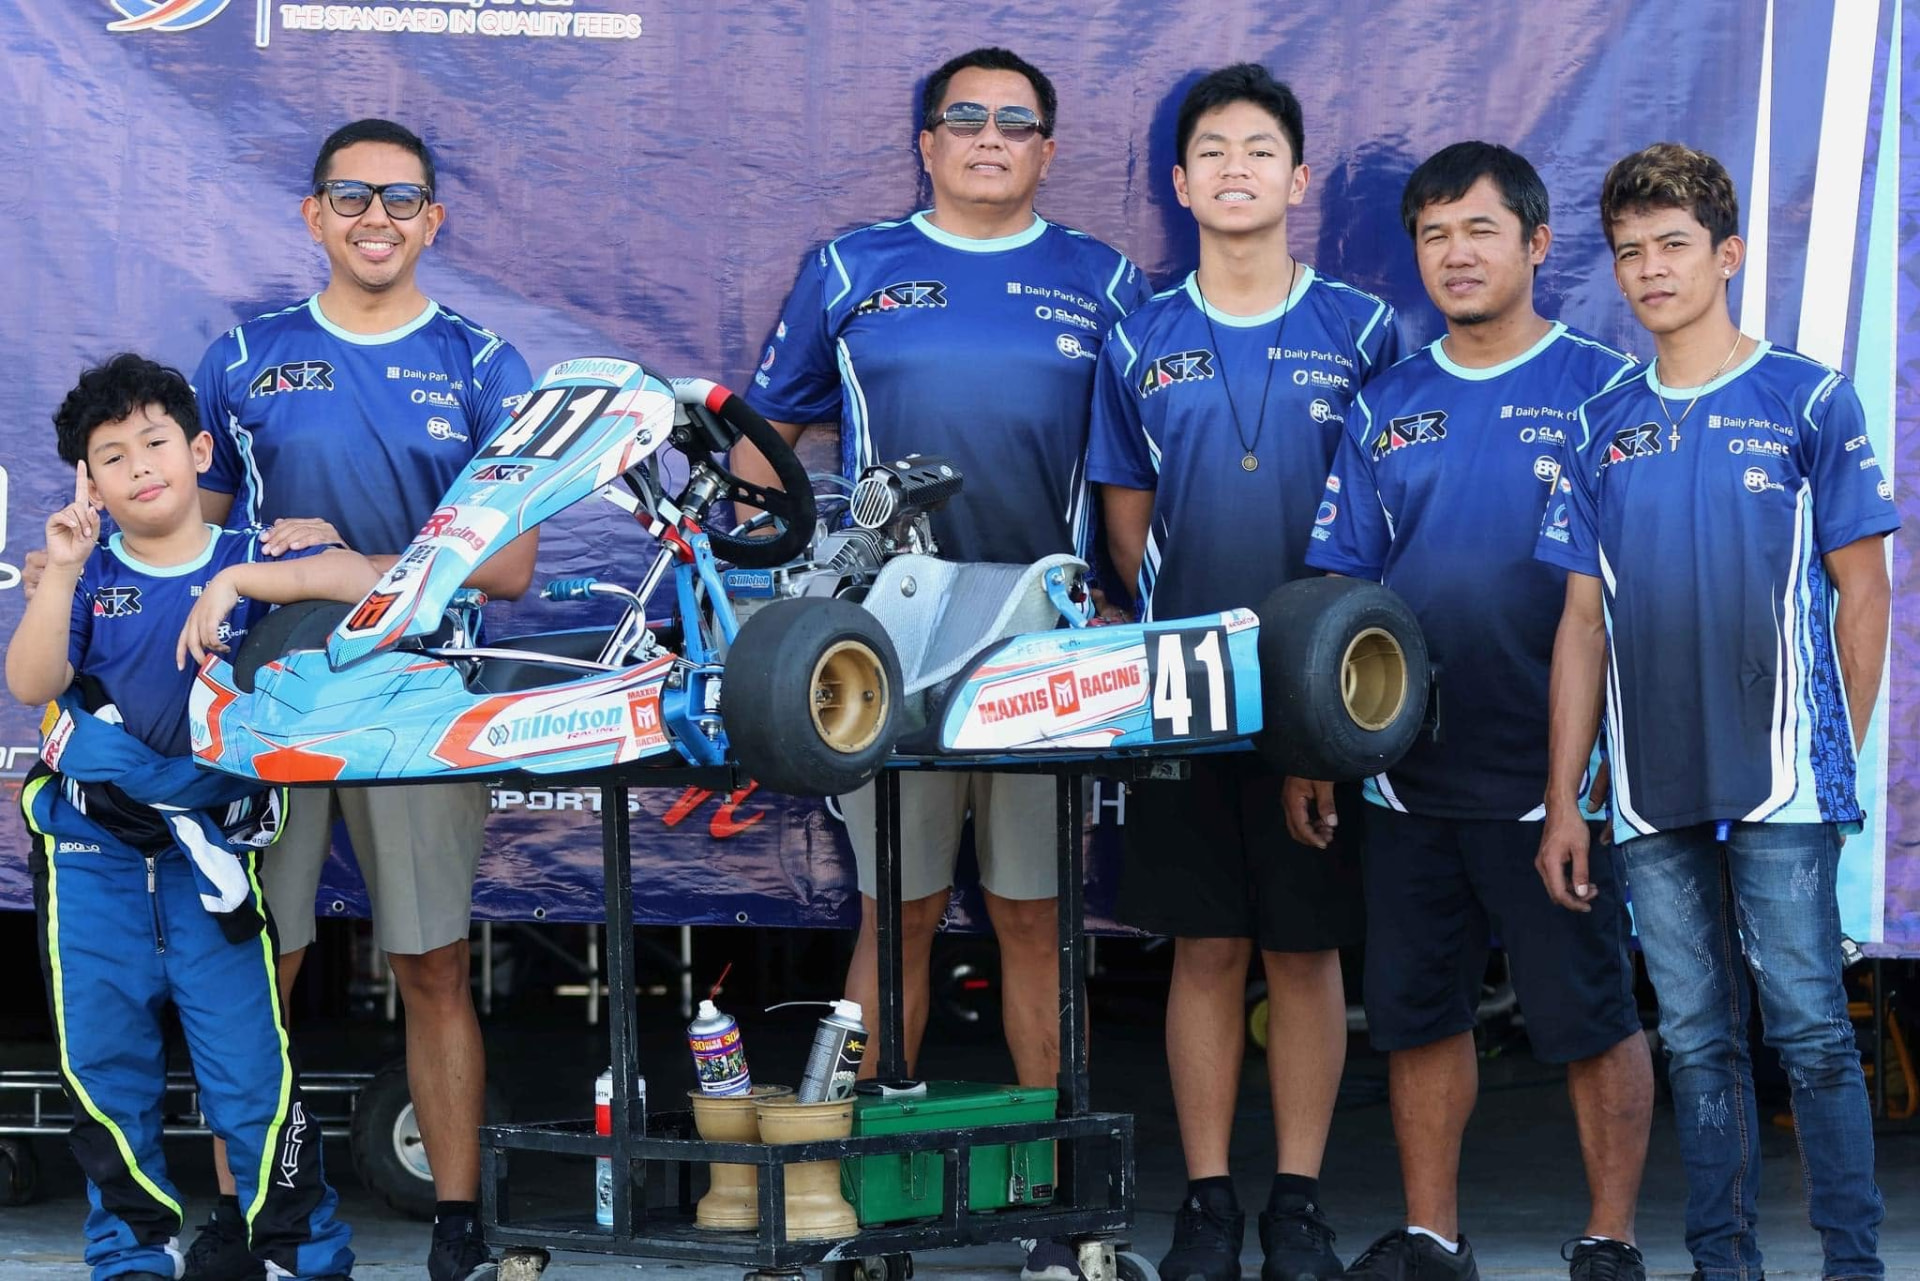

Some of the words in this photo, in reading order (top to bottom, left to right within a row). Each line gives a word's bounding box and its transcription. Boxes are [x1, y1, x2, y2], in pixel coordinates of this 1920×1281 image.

[281, 6, 323, 28] THE
[325, 7, 446, 31] STANDARD
[451, 10, 475, 32] IN
[478, 10, 571, 36] QUALITY
[575, 13, 641, 38] FEEDS
[1025, 286, 1051, 298] Daily
[1054, 290, 1076, 304] Park
[1077, 297, 1098, 313] Café
[1284, 349, 1308, 360] Daily
[1311, 350, 1333, 362] Park
[403, 369, 427, 381] Daily
[567, 359, 629, 375] Tillotson
[429, 391, 459, 402] CLA
[487, 387, 596, 459] 41
[1515, 407, 1539, 419] Daily
[1541, 407, 1564, 419] Park
[1539, 427, 1566, 441] CLA
[1723, 417, 1747, 429] Daily
[1749, 418, 1771, 429] Park
[1772, 423, 1794, 437] Café
[94, 585, 143, 618] GR
[627, 687, 658, 700] MAXXIS
[1153, 630, 1229, 736] 41
[978, 690, 1049, 725] MAXXIS
[1080, 664, 1141, 699] RACING
[510, 706, 623, 743] Tillotson
[491, 789, 641, 812] PORTS
